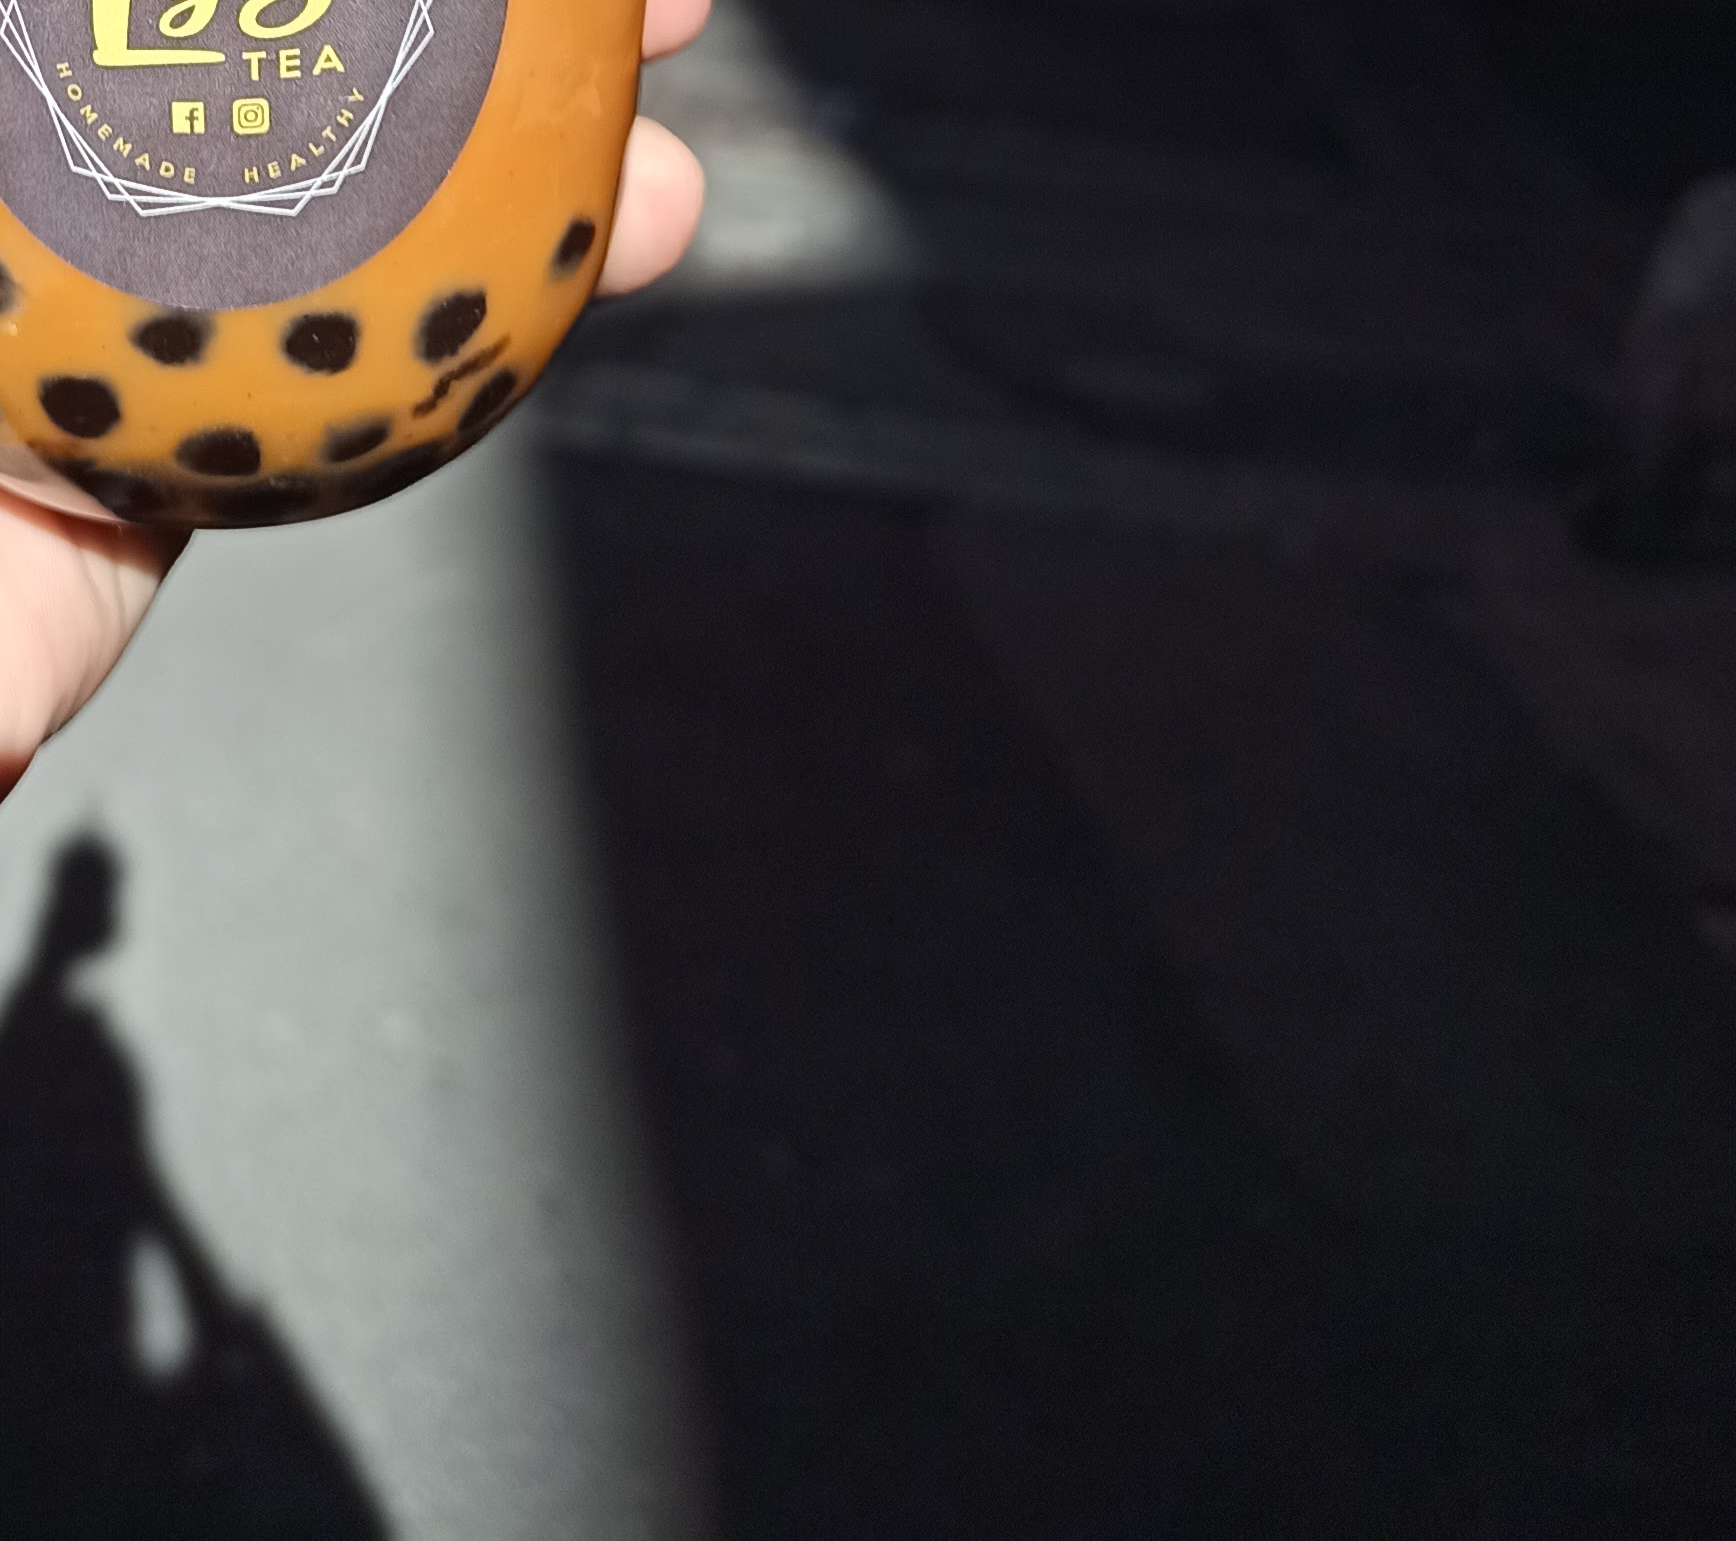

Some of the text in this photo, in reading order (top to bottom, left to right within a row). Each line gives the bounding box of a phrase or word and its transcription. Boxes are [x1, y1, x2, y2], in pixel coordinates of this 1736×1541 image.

[241, 44, 346, 82] TEA
[56, 61, 365, 185] HOMEMADE HEALTHY
